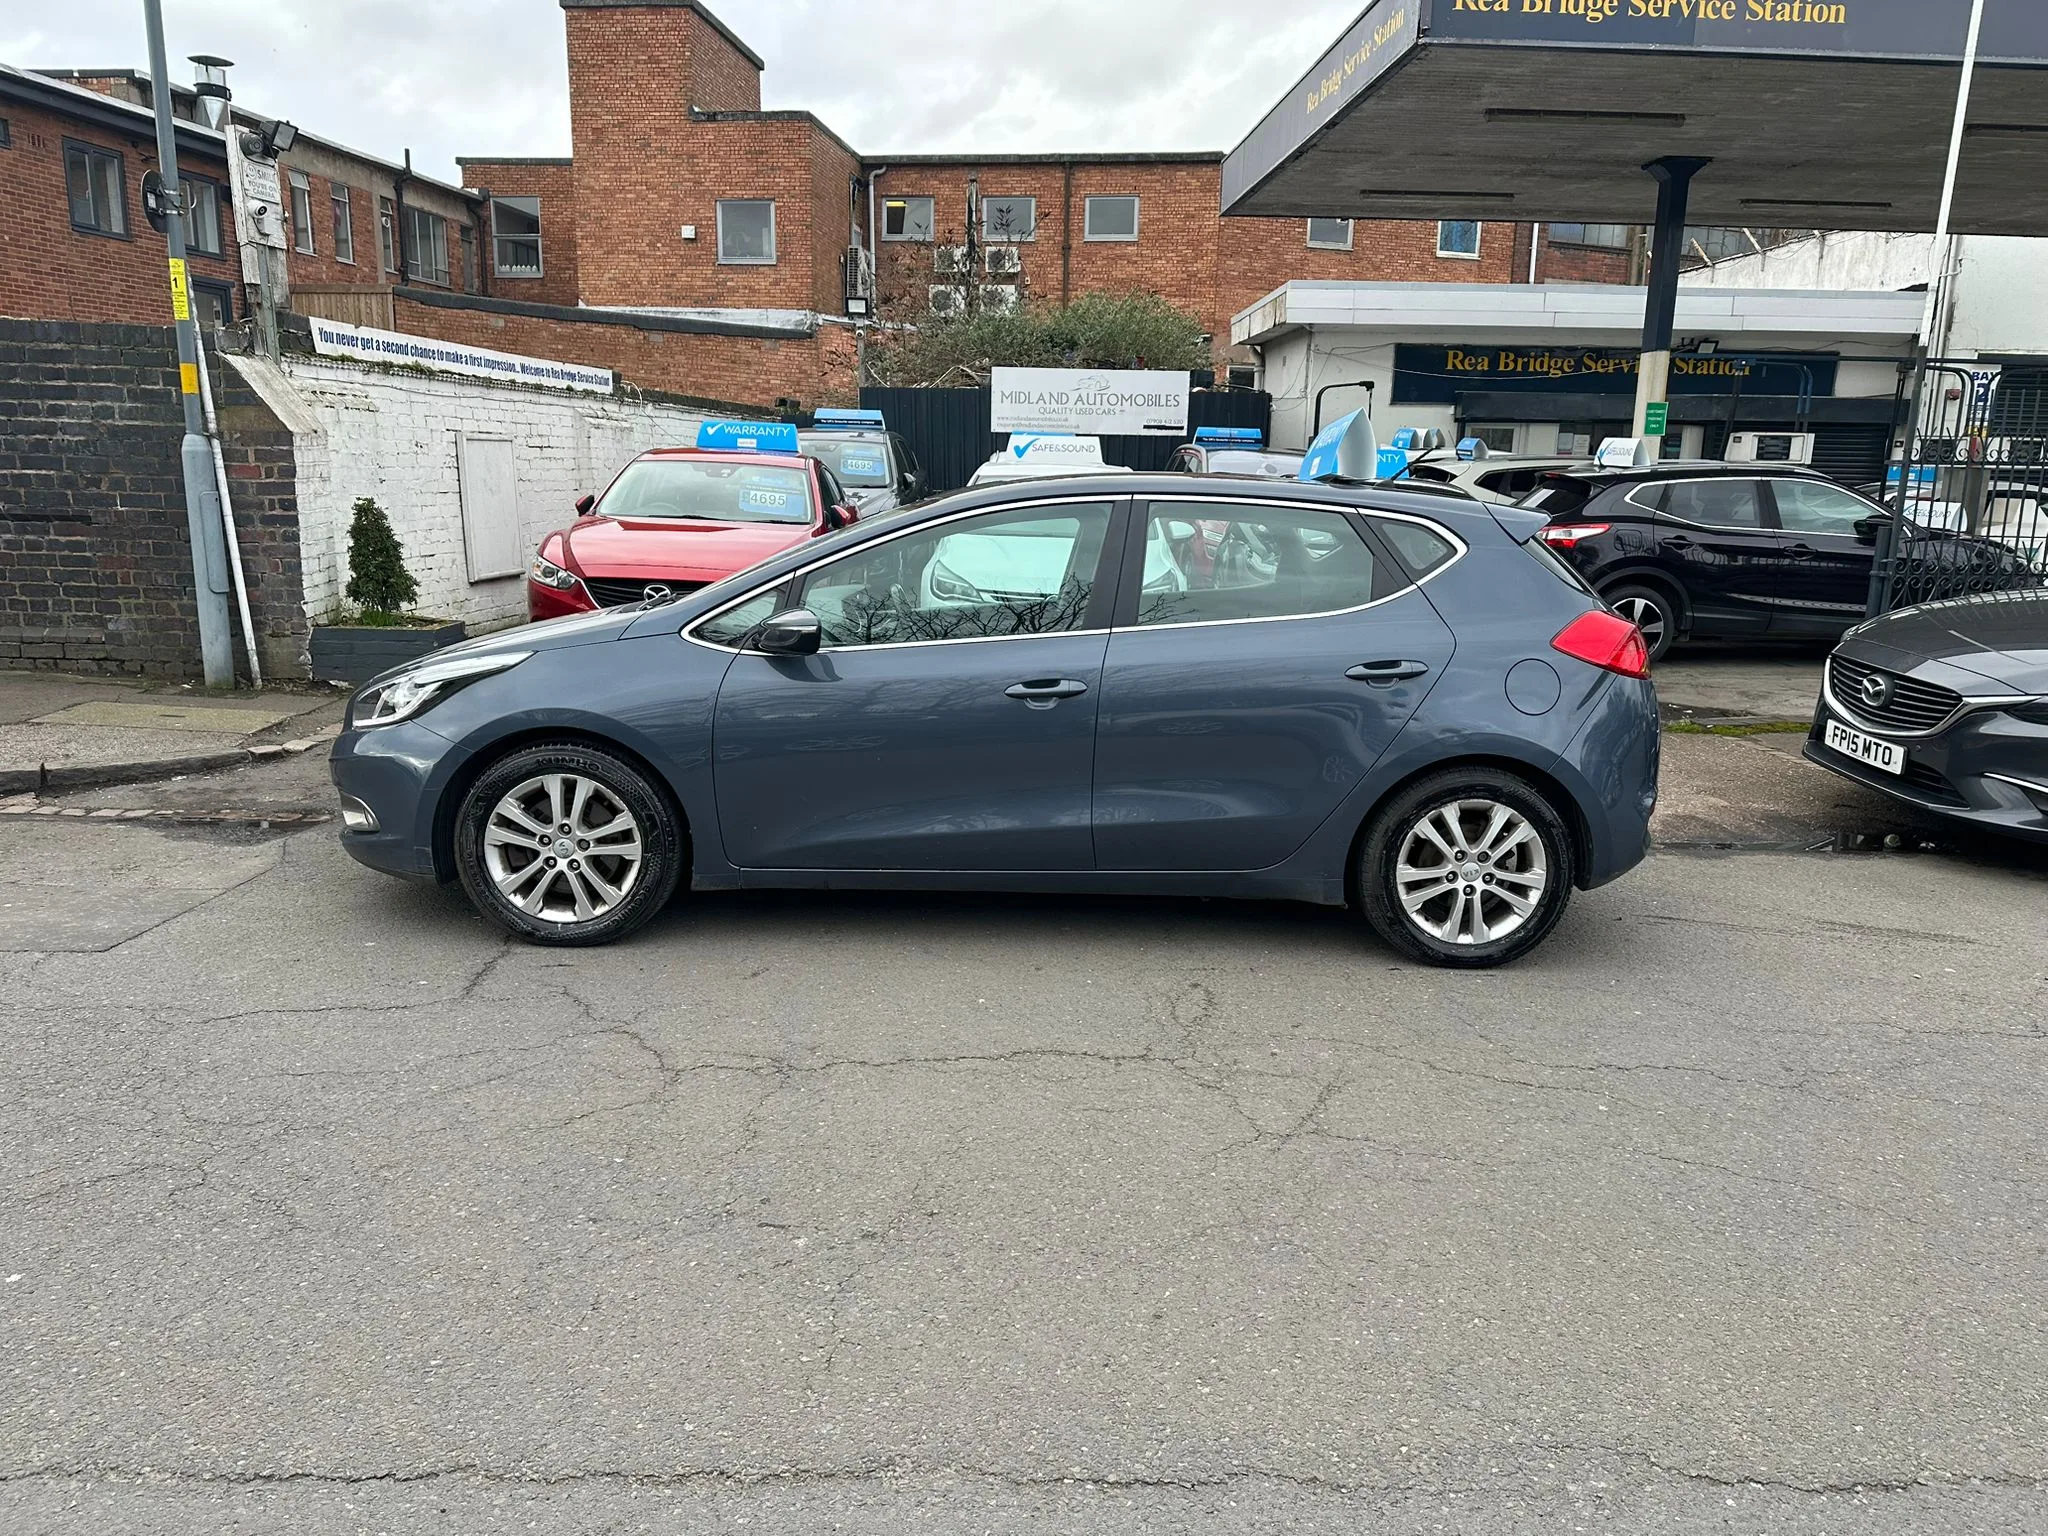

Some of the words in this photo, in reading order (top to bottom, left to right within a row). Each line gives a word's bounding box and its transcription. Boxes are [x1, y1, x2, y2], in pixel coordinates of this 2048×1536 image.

[1628, 0, 1736, 20] Service
[1745, 0, 1846, 24] Station
[1307, 92, 1319, 114] Rea
[1320, 69, 1342, 101] Bridge
[1343, 40, 1371, 80] Service
[1373, 8, 1404, 51] Station
[172, 277, 178, 289] 1
[318, 327, 334, 344] You
[336, 332, 359, 348] never
[360, 336, 374, 351] get
[375, 340, 381, 351] a
[382, 340, 409, 356] second
[410, 344, 436, 360] chance
[437, 348, 445, 362] to
[445, 350, 463, 364] make
[464, 355, 469, 365] a
[469, 353, 483, 368] first
[520, 362, 545, 378] Welcome
[545, 368, 550, 378] to
[551, 367, 560, 380] Rea
[560, 369, 577, 383] Bridge
[577, 371, 594, 385] Service
[594, 373, 610, 387] Station
[1445, 349, 1489, 371] Rea
[1497, 351, 1575, 378] Bridge
[1582, 352, 1640, 374] Servi
[1000, 390, 1069, 405] MIDLAND
[1074, 392, 1180, 408] AUTOMOBILES
[1976, 382, 1989, 403] 2
[1038, 407, 1074, 416] QUALITY
[1075, 407, 1094, 416] USED
[1095, 408, 1116, 416] CARS
[723, 425, 791, 437] WARRANTY
[1031, 443, 1096, 453] SAFE&SOUND
[1832, 725, 1860, 753] FP15
[1861, 737, 1893, 766] MTO
